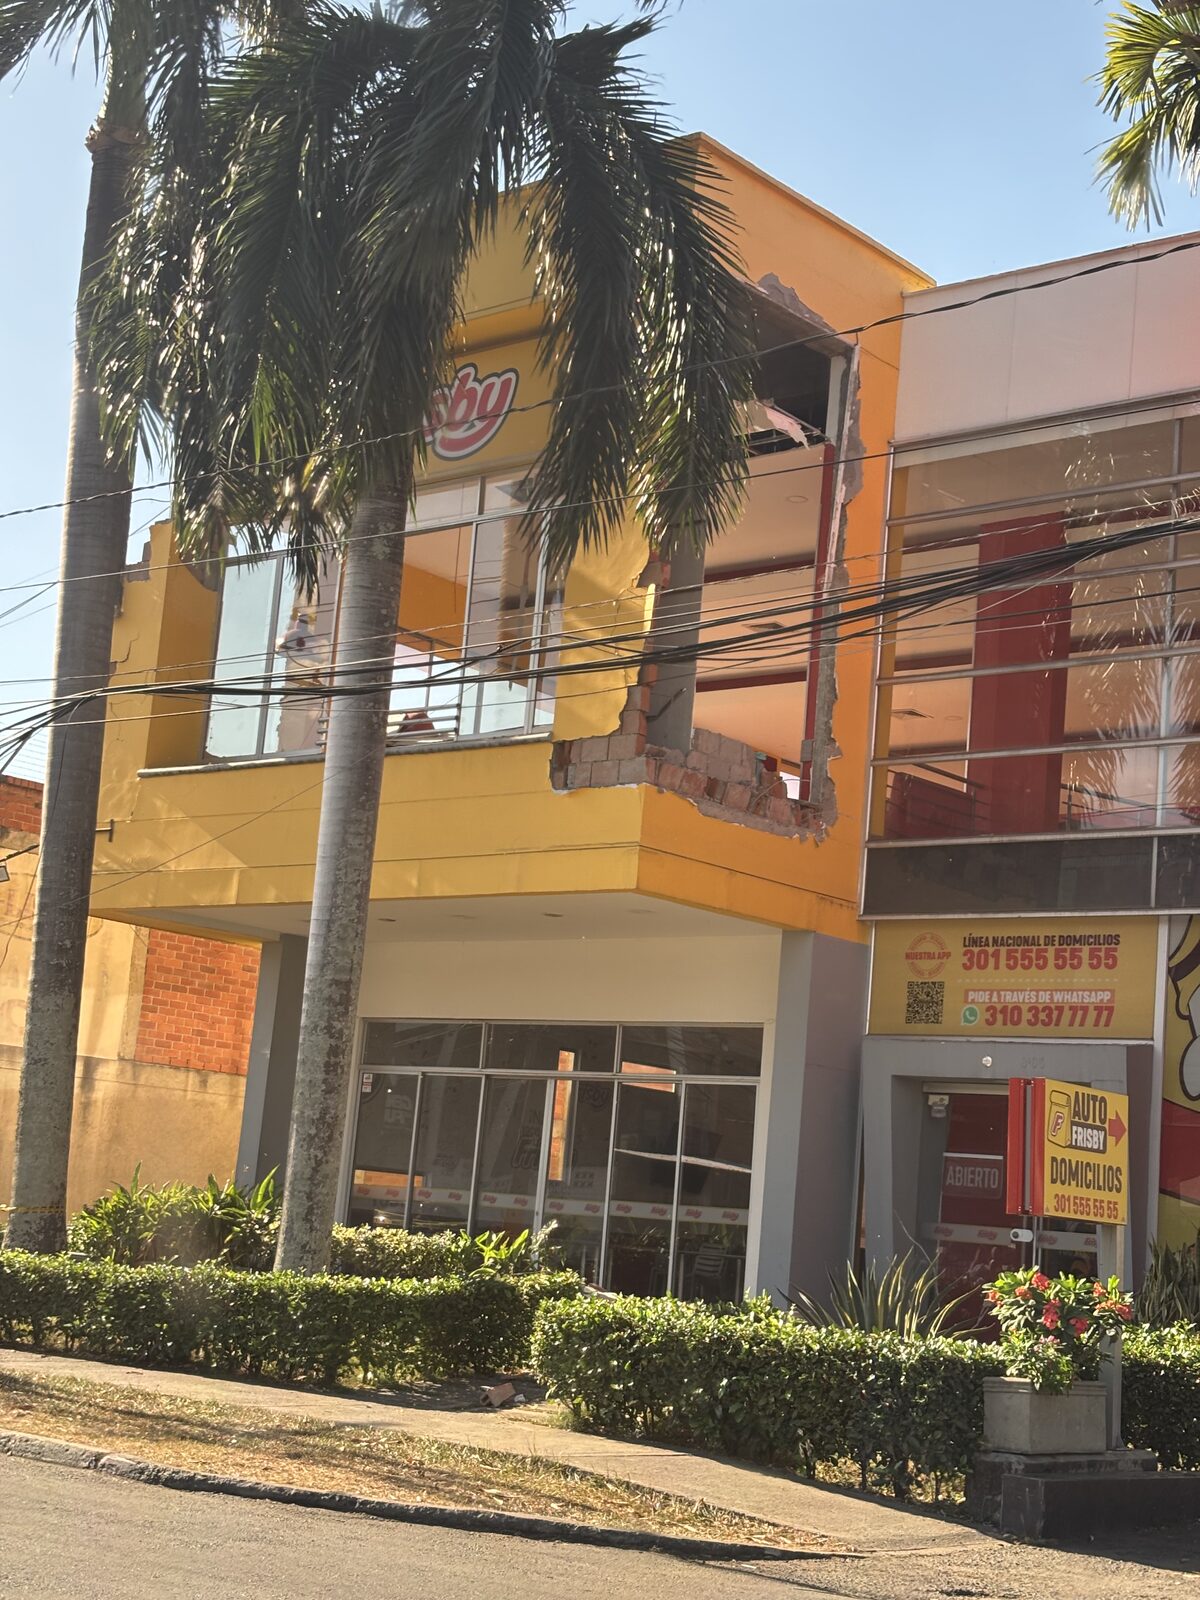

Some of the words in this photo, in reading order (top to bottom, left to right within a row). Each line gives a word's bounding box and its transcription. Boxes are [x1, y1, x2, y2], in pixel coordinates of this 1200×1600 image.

[963, 933, 990, 948] LÍNEA
[992, 935, 1042, 948] NACIONAL
[1043, 934, 1056, 947] DE
[1058, 934, 1121, 946] DOMICILIOS
[905, 951, 936, 960] NUESTRA
[937, 951, 951, 960] APP
[962, 948, 1001, 971] 301
[1005, 948, 1049, 971] 555
[1054, 947, 1083, 970] 55
[1088, 947, 1118, 970] 55
[968, 991, 991, 1002] PIDE
[991, 991, 998, 1002] A
[1000, 988, 1037, 1003] TRAVÉS
[1039, 991, 1051, 1002] DE
[1053, 991, 1111, 1003] WHATSAPP
[985, 1005, 1023, 1026] 310
[1026, 1005, 1064, 1027] 337
[1068, 1005, 1090, 1027] 77
[1093, 1005, 1115, 1027] 77
[1072, 1091, 1107, 1125] AUTO
[1072, 1126, 1105, 1150] FRISBY
[946, 1166, 999, 1188] ABIERTO
[1051, 1156, 1122, 1193] DOMICILIOS
[1054, 1193, 1071, 1213] 301
[1073, 1196, 1091, 1216] 555
[1093, 1198, 1105, 1218] 55
[1107, 1200, 1119, 1220] 55
